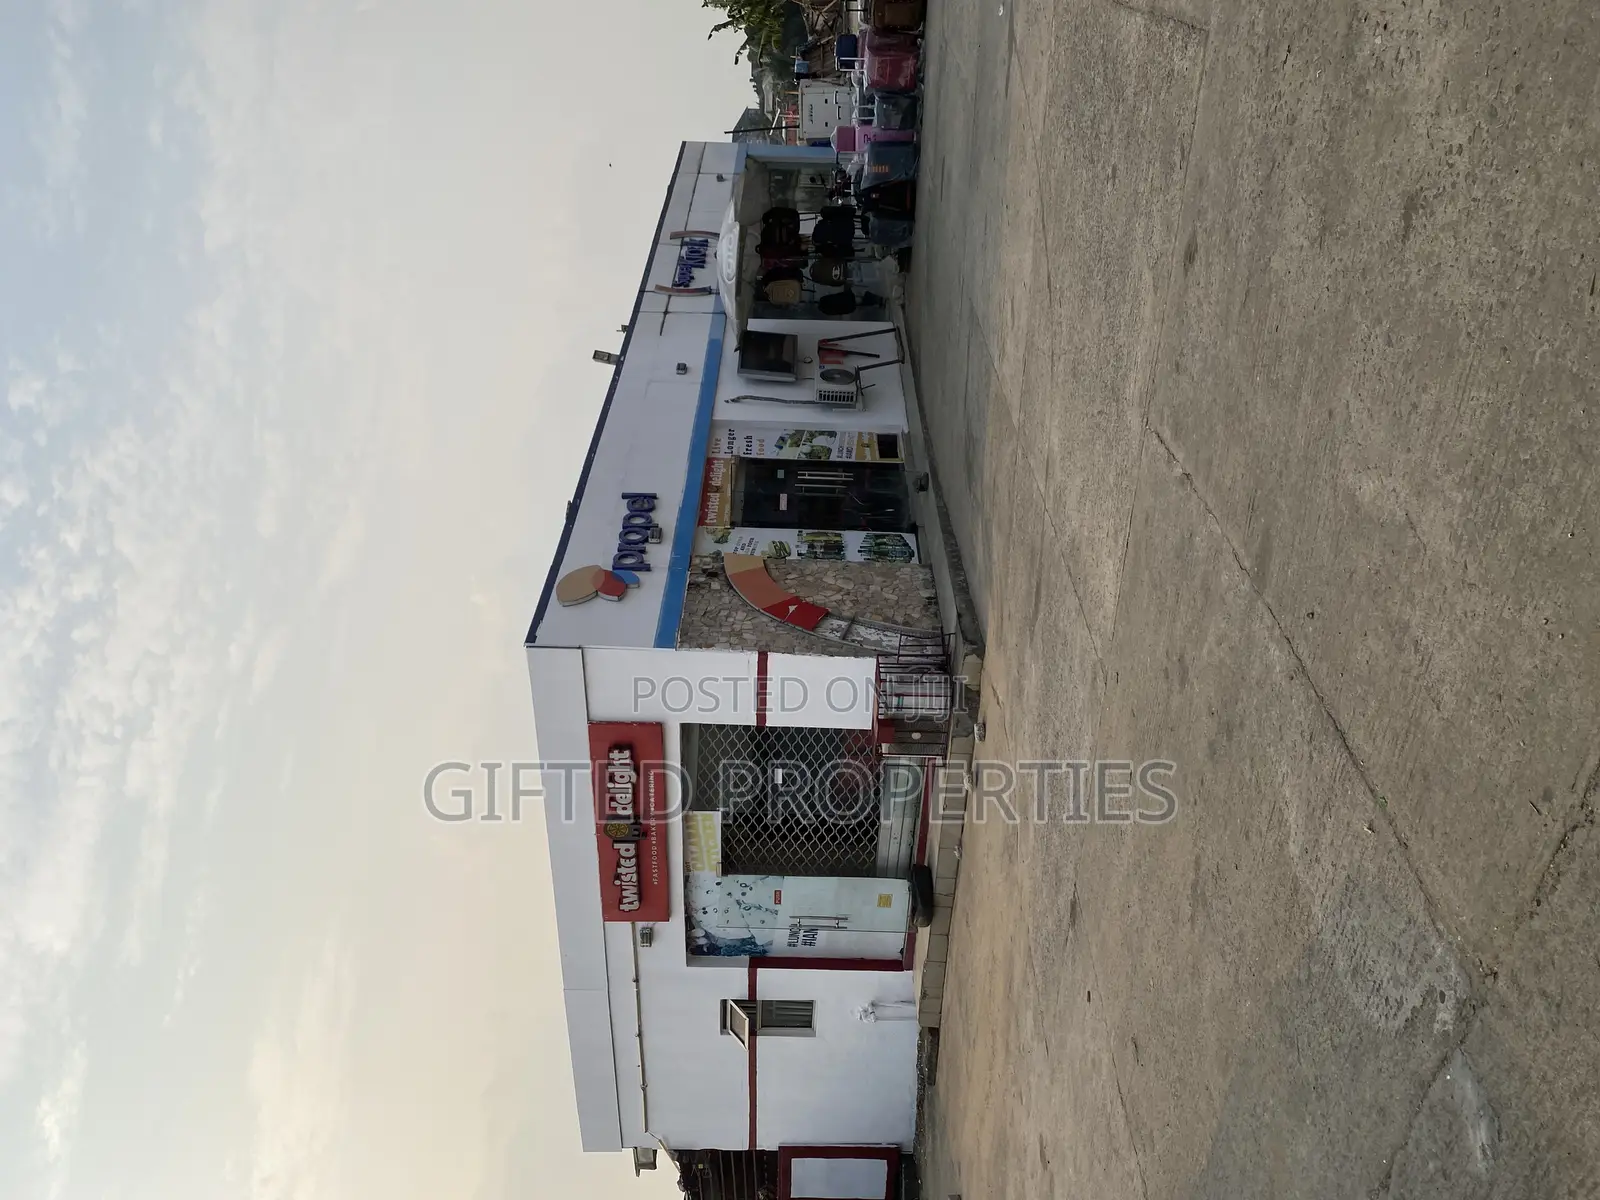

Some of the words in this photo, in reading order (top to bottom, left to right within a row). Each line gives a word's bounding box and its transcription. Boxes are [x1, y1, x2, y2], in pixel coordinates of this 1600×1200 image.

[724, 428, 736, 455] Longer
[742, 435, 752, 456] fresh
[756, 438, 764, 456] food
[708, 460, 726, 486] delight
[704, 492, 720, 523] twisted
[611, 492, 659, 571] propel
[606, 748, 639, 815] delight
[613, 842, 641, 911] twisted
